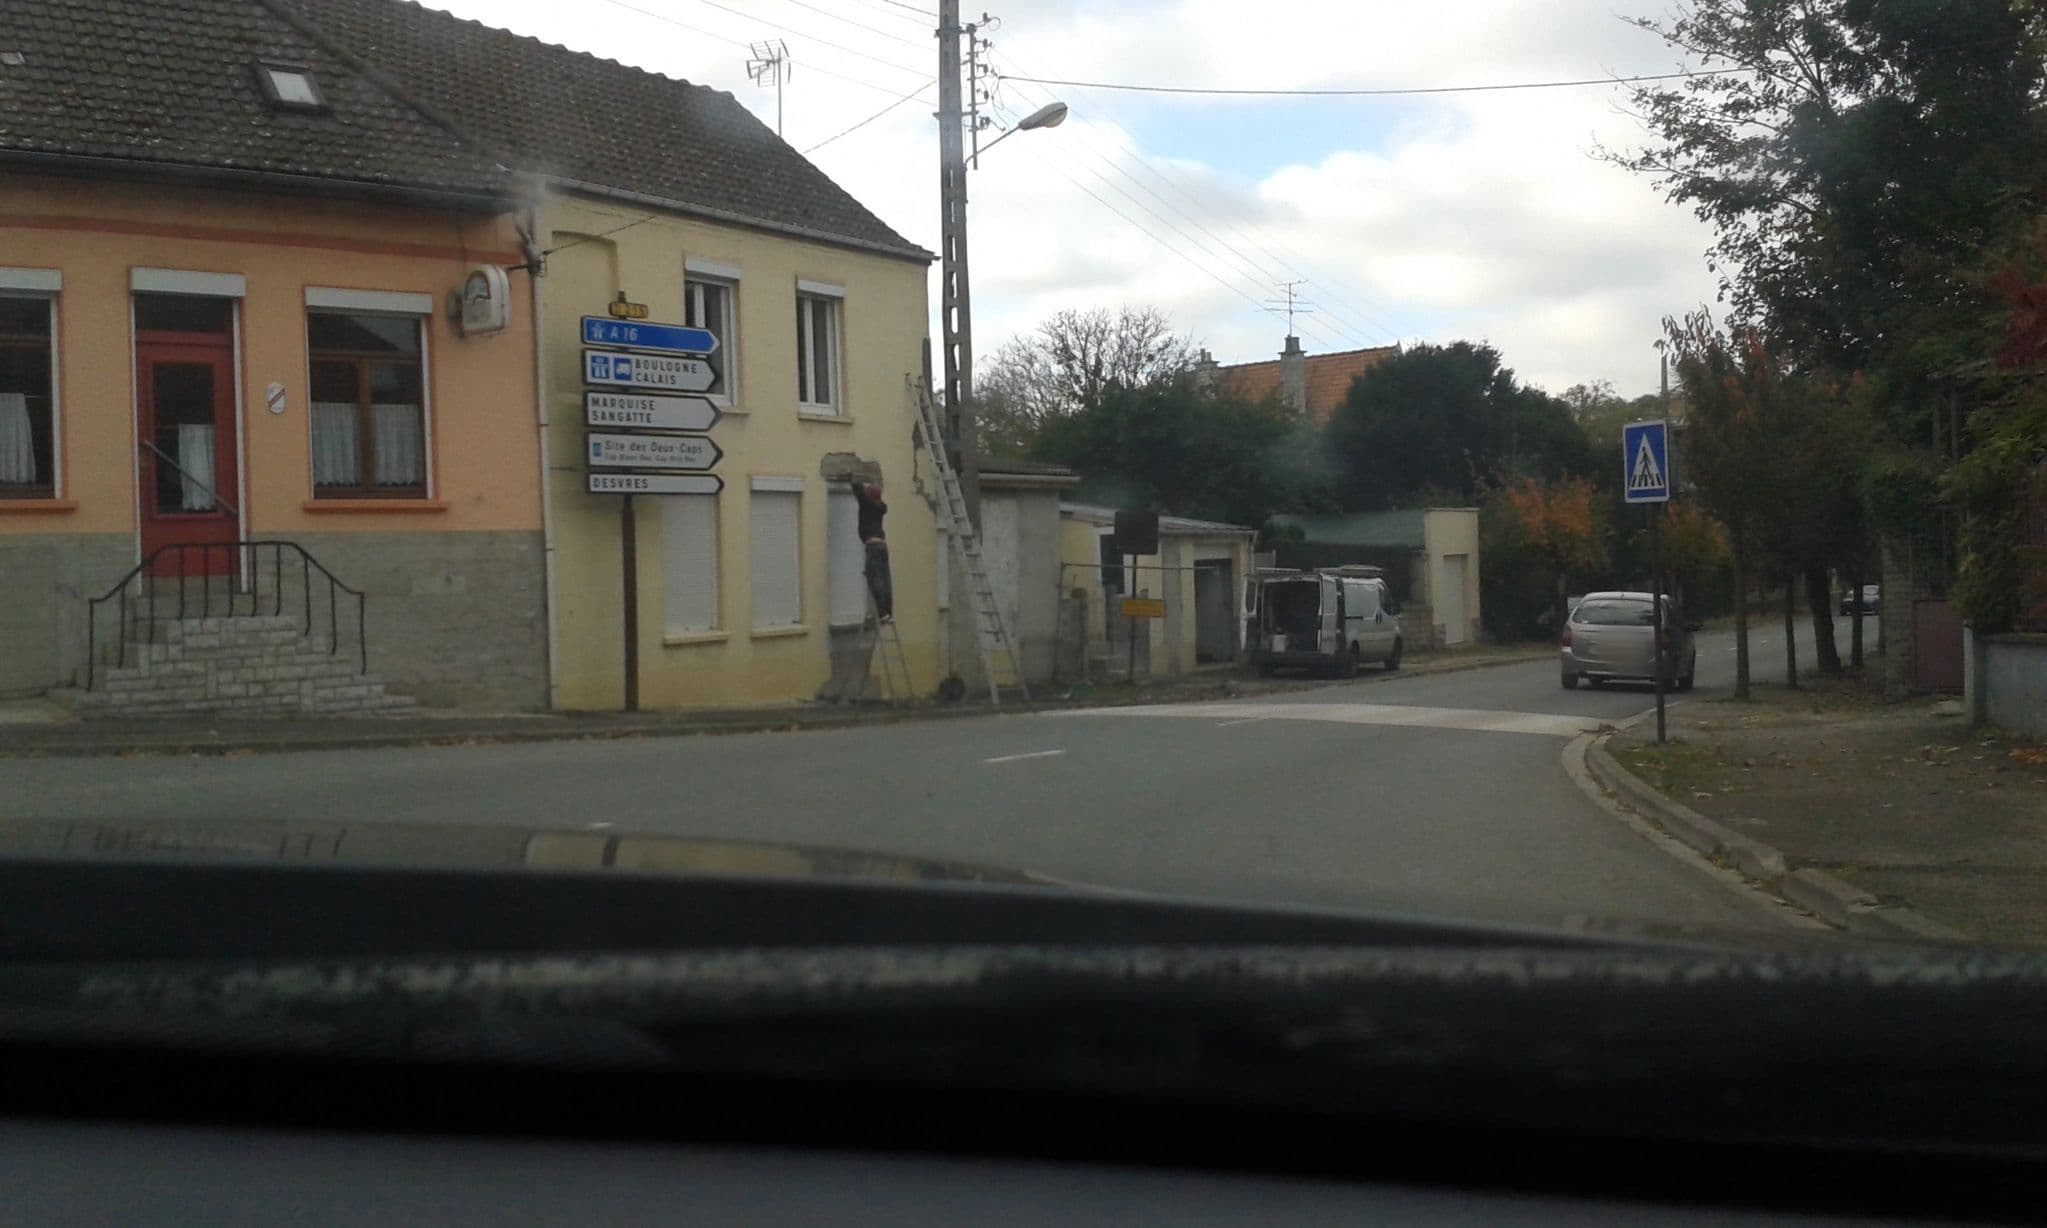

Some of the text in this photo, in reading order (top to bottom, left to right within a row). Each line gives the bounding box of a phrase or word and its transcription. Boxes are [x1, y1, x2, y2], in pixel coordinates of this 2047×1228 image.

[610, 327, 639, 341] A 16
[635, 358, 697, 374] BOULOGNE
[635, 373, 677, 385] CALAIS
[591, 397, 656, 411] MARQUISE
[592, 410, 653, 423] SANGATTE
[592, 478, 649, 489] DESVRES
